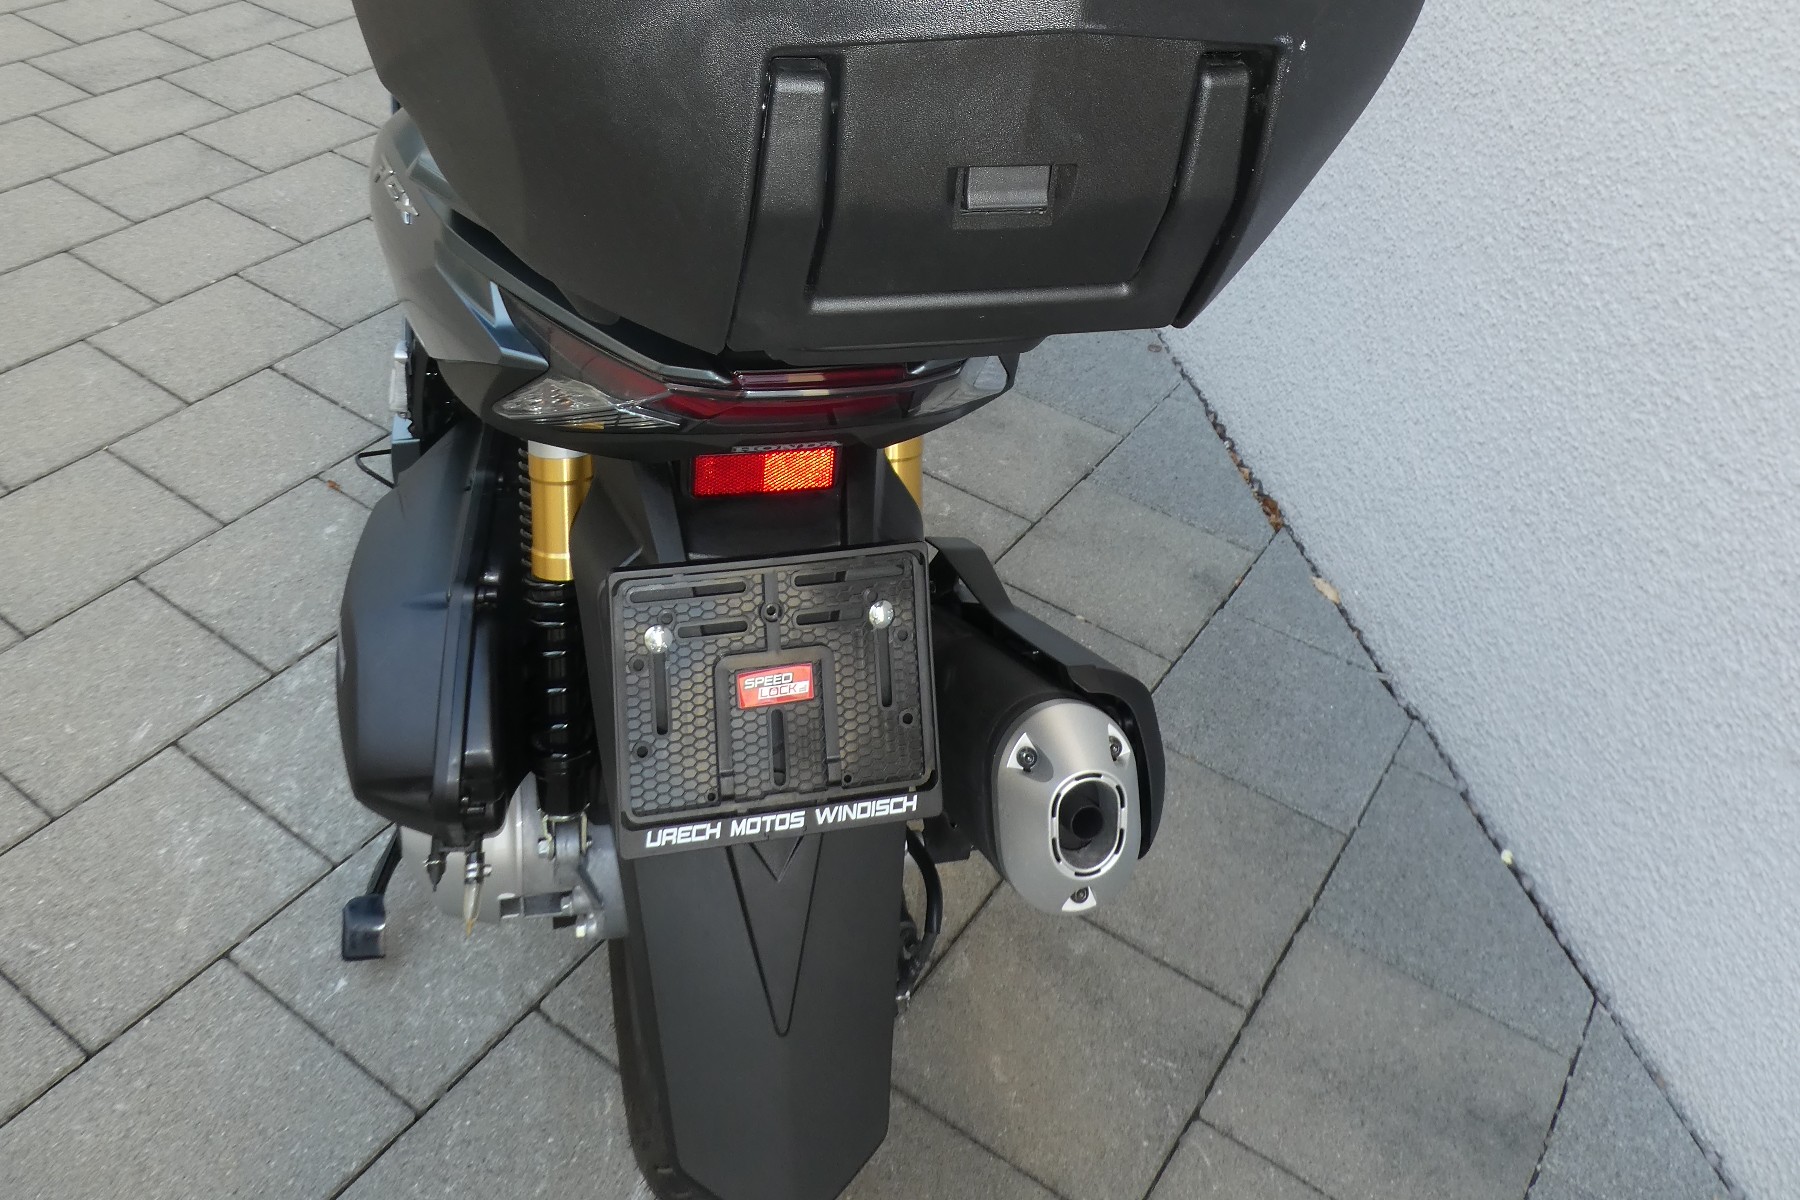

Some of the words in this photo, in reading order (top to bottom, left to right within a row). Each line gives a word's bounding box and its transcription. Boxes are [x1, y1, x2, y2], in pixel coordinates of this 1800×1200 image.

[743, 672, 794, 690] SPEED
[759, 683, 797, 699] LOCK
[645, 821, 722, 848] URECH
[729, 810, 806, 838] MOTOS
[815, 794, 918, 826] WINDISCH
